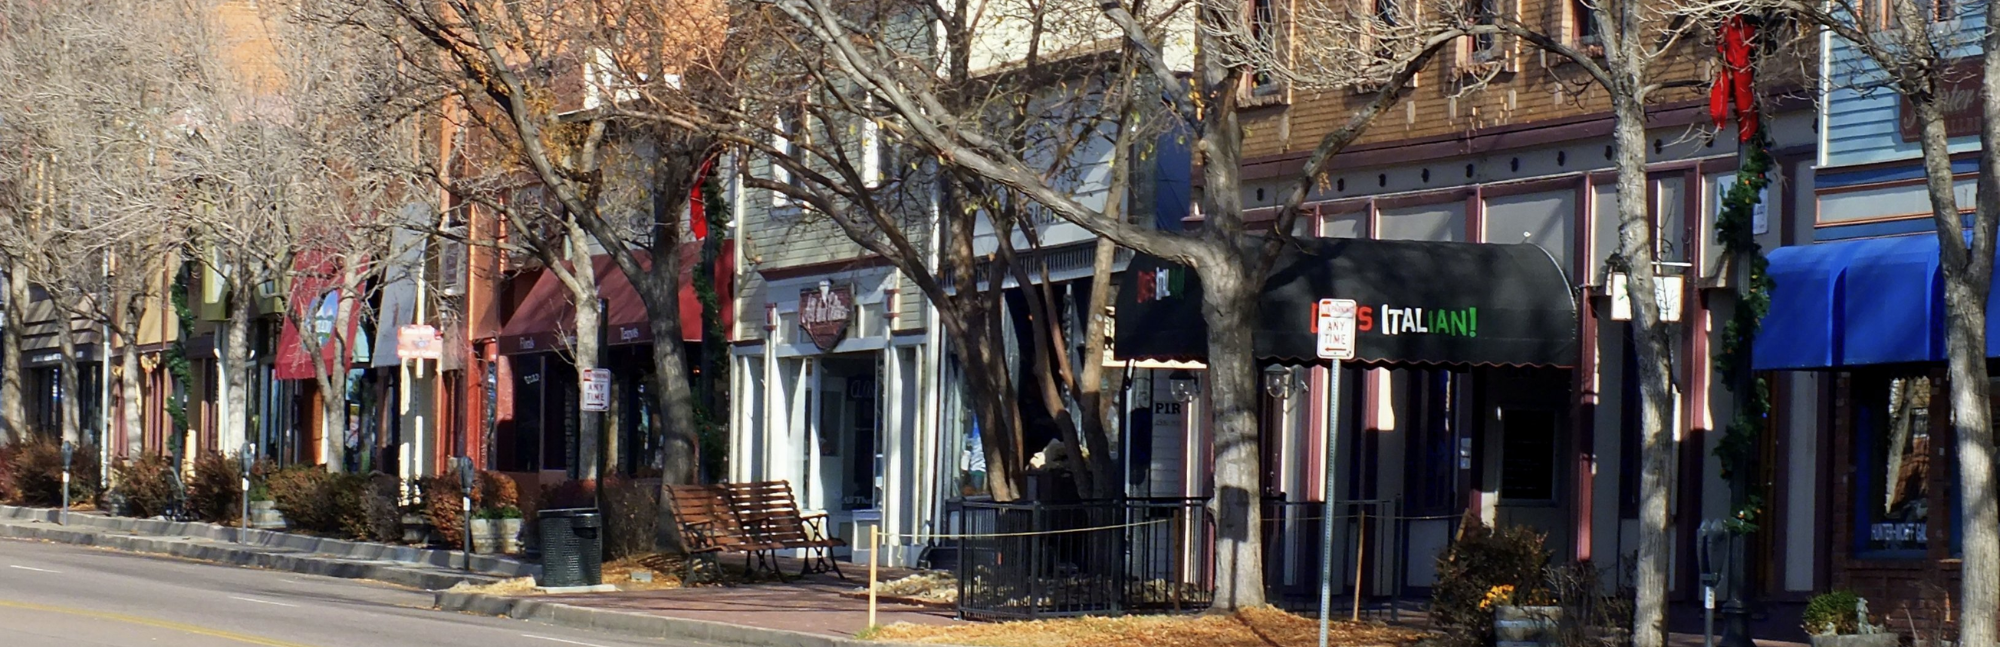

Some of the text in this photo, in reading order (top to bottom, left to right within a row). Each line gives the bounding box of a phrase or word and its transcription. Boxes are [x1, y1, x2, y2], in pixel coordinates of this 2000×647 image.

[1327, 321, 1345, 332] ANY
[1381, 304, 1477, 338] ITALIAN!
[1324, 333, 1346, 345] TIME
[586, 393, 605, 401] TIME
